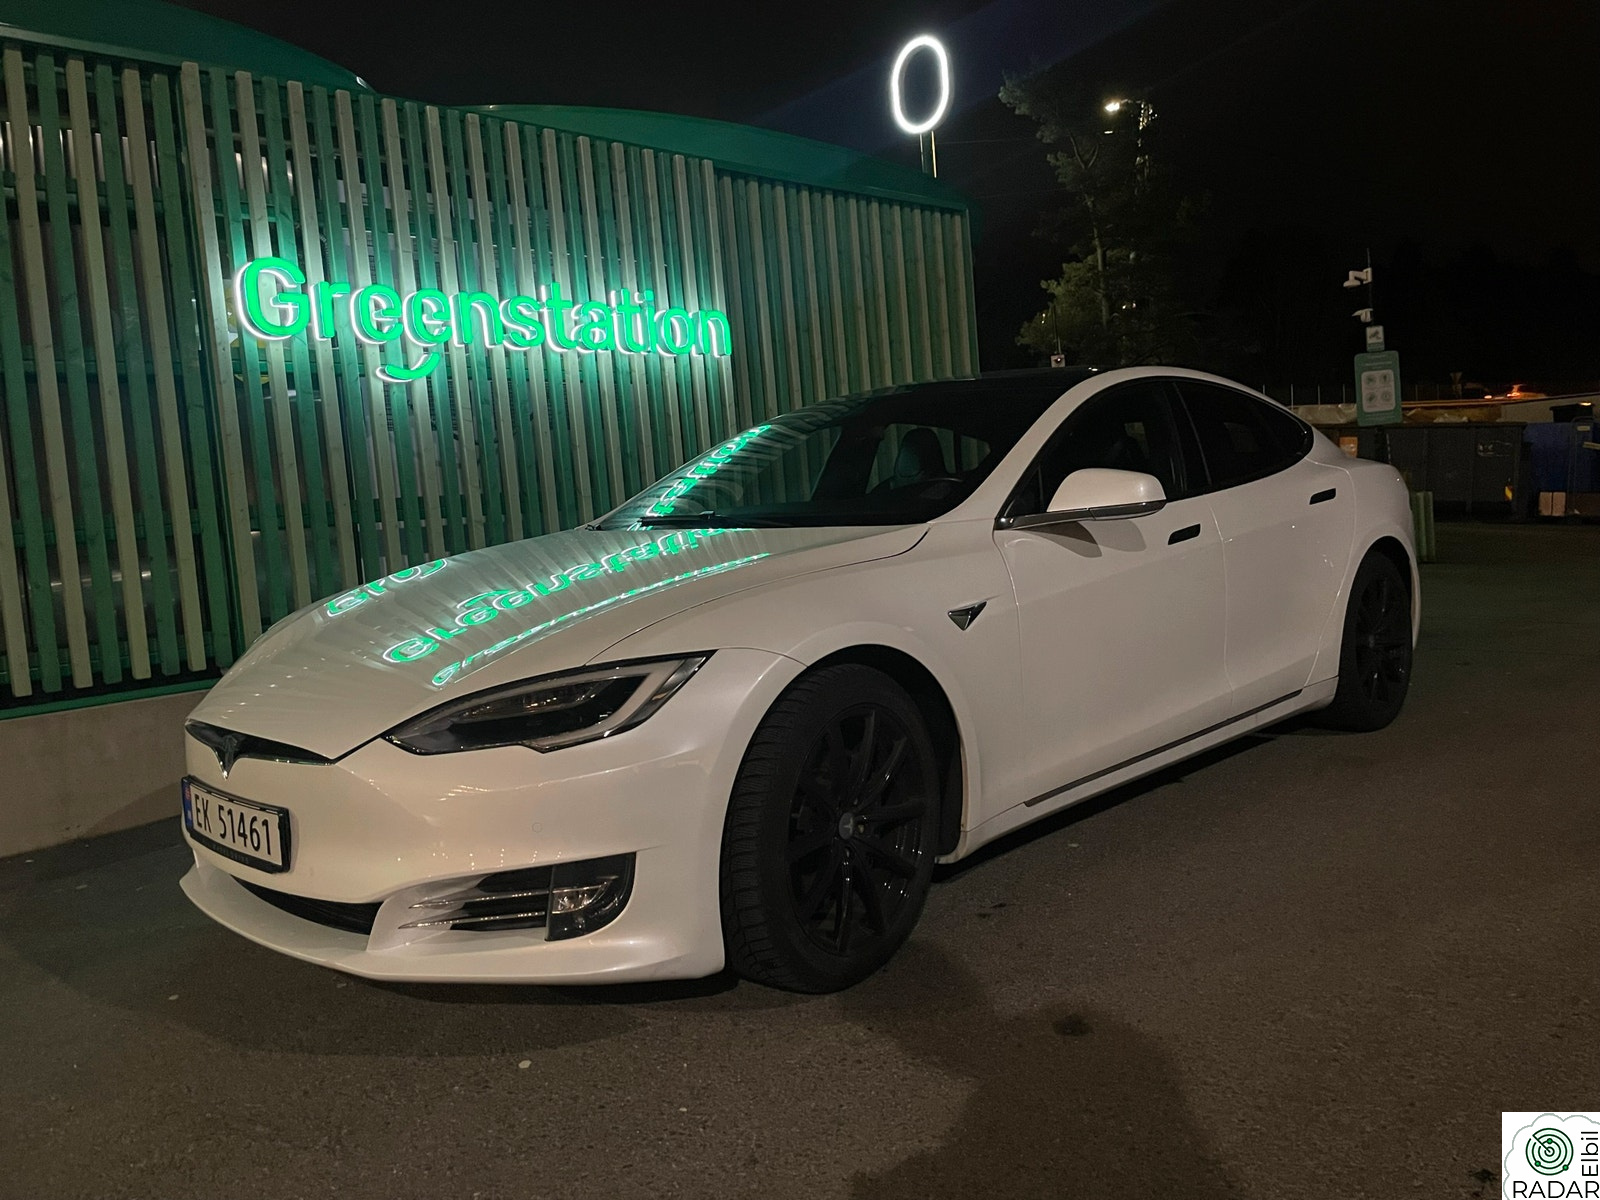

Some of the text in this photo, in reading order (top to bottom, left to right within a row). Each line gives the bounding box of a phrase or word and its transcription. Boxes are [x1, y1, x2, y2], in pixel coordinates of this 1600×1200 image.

[235, 256, 732, 382] Greenstation
[194, 793, 212, 833] EK
[218, 804, 271, 855] 51461
